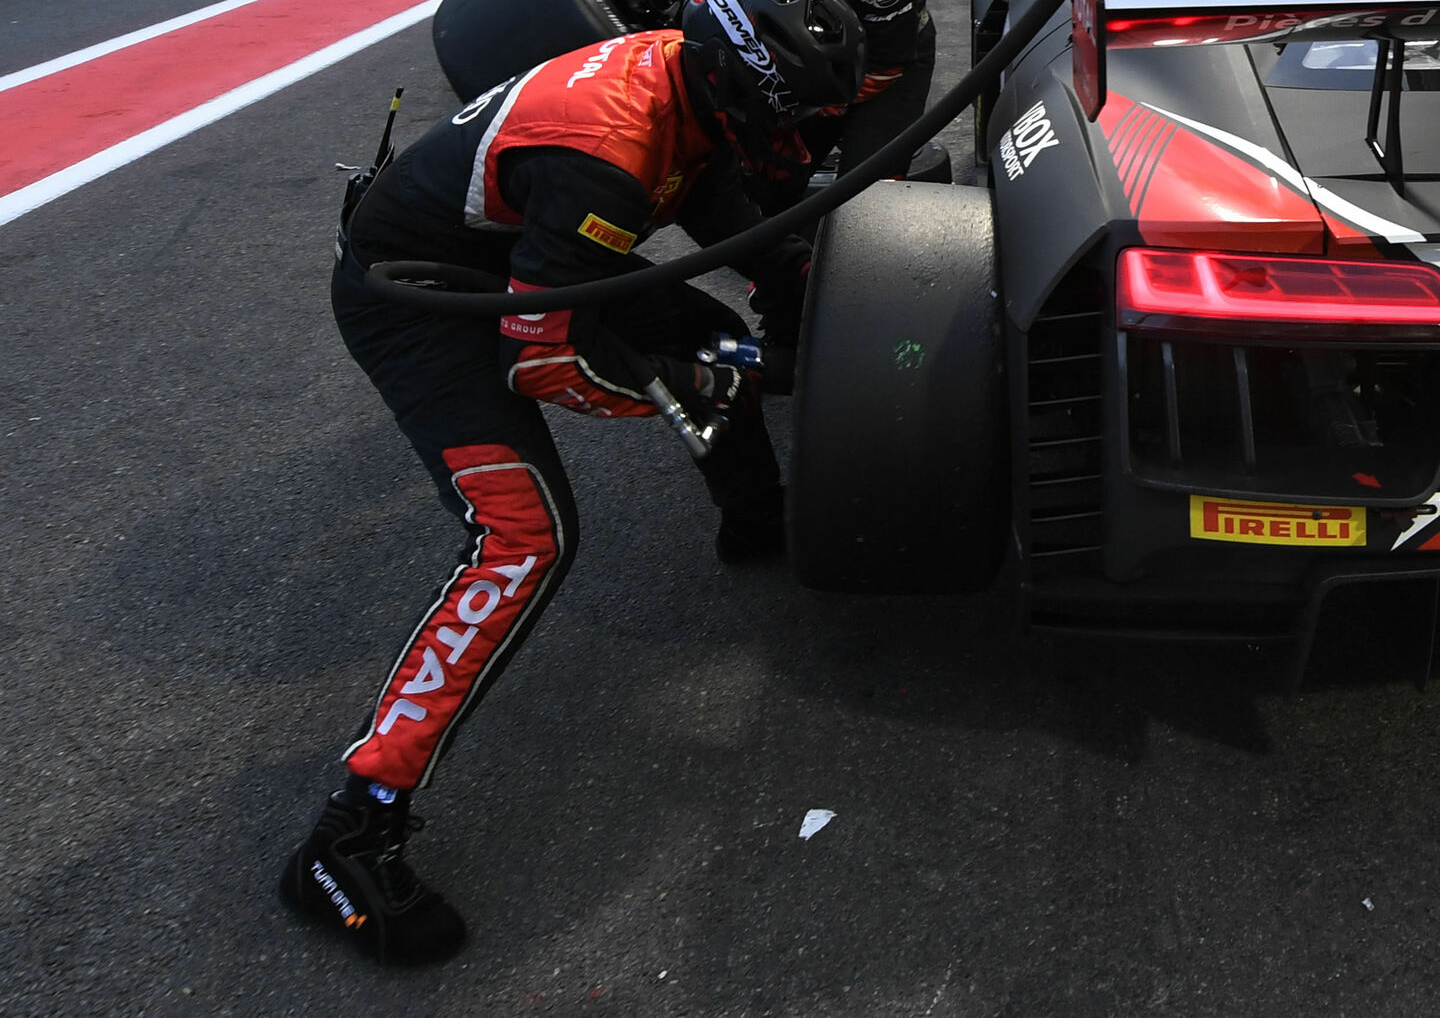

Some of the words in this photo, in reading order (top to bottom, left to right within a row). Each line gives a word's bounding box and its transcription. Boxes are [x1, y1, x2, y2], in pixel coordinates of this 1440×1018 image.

[1224, 7, 1387, 32] Pièces
[1010, 100, 1062, 169] VBOX
[511, 322, 544, 335] GROUP
[1201, 500, 1353, 540] PIRELLI
[377, 554, 536, 735] TOTAL
